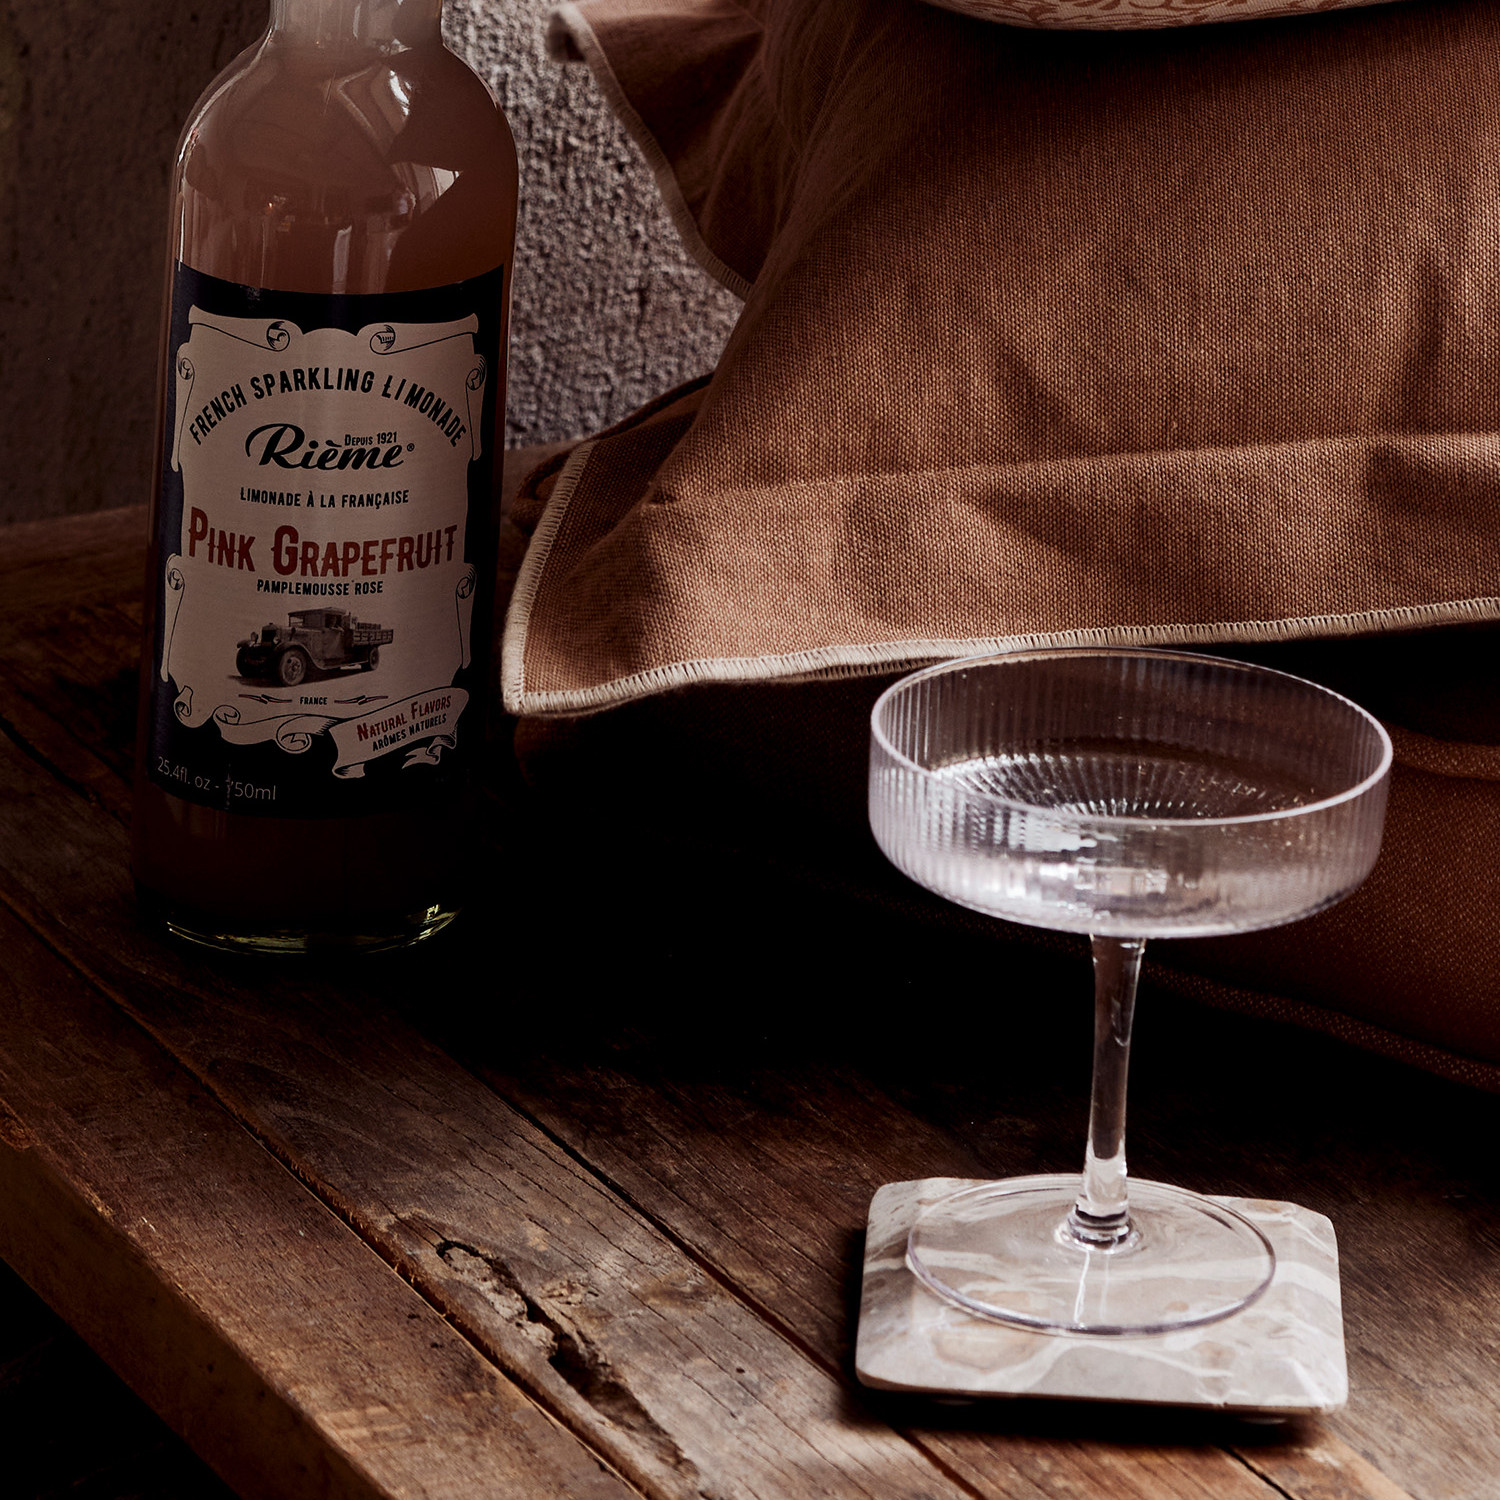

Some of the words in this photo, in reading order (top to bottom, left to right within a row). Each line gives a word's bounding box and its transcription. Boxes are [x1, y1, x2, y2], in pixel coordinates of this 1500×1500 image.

[189, 383, 248, 446] FRENCH
[250, 367, 375, 399] SPARKLING
[381, 375, 467, 447] LIMONADE
[376, 431, 397, 444] 1921
[240, 487, 301, 506] LIMONADE
[306, 491, 314, 507] À
[320, 494, 336, 508] LA
[341, 490, 409, 509] FRANÇAISE
[257, 579, 349, 596] PAMPLEMOUSSE
[354, 581, 383, 595] ROSE
[299, 696, 328, 706] FRANCE
[373, 729, 407, 751] ARÔMES
[409, 713, 446, 736] NATURELS
[194, 776, 211, 791] oz
